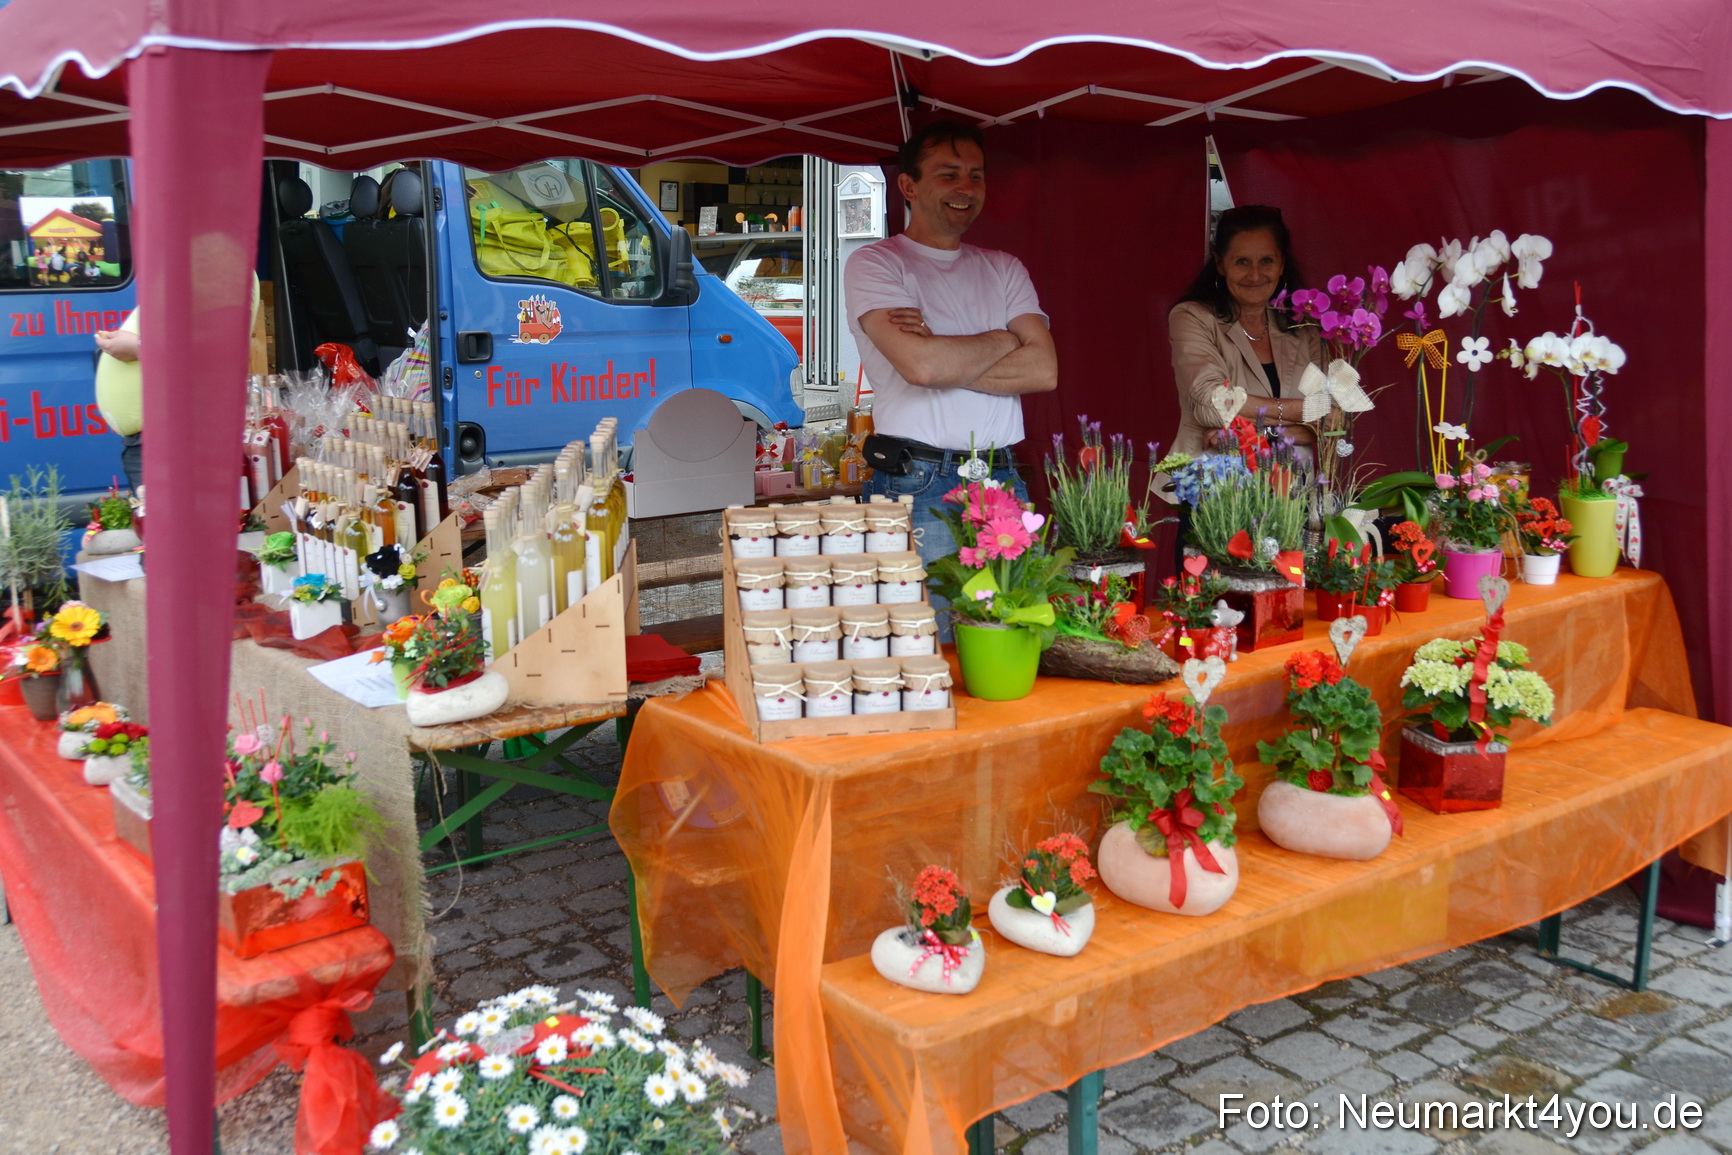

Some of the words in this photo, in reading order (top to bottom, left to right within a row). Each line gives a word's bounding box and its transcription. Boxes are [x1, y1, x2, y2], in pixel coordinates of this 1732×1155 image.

[10, 313, 45, 337] zu
[486, 365, 540, 408] Für
[551, 357, 656, 404] Kinder!
